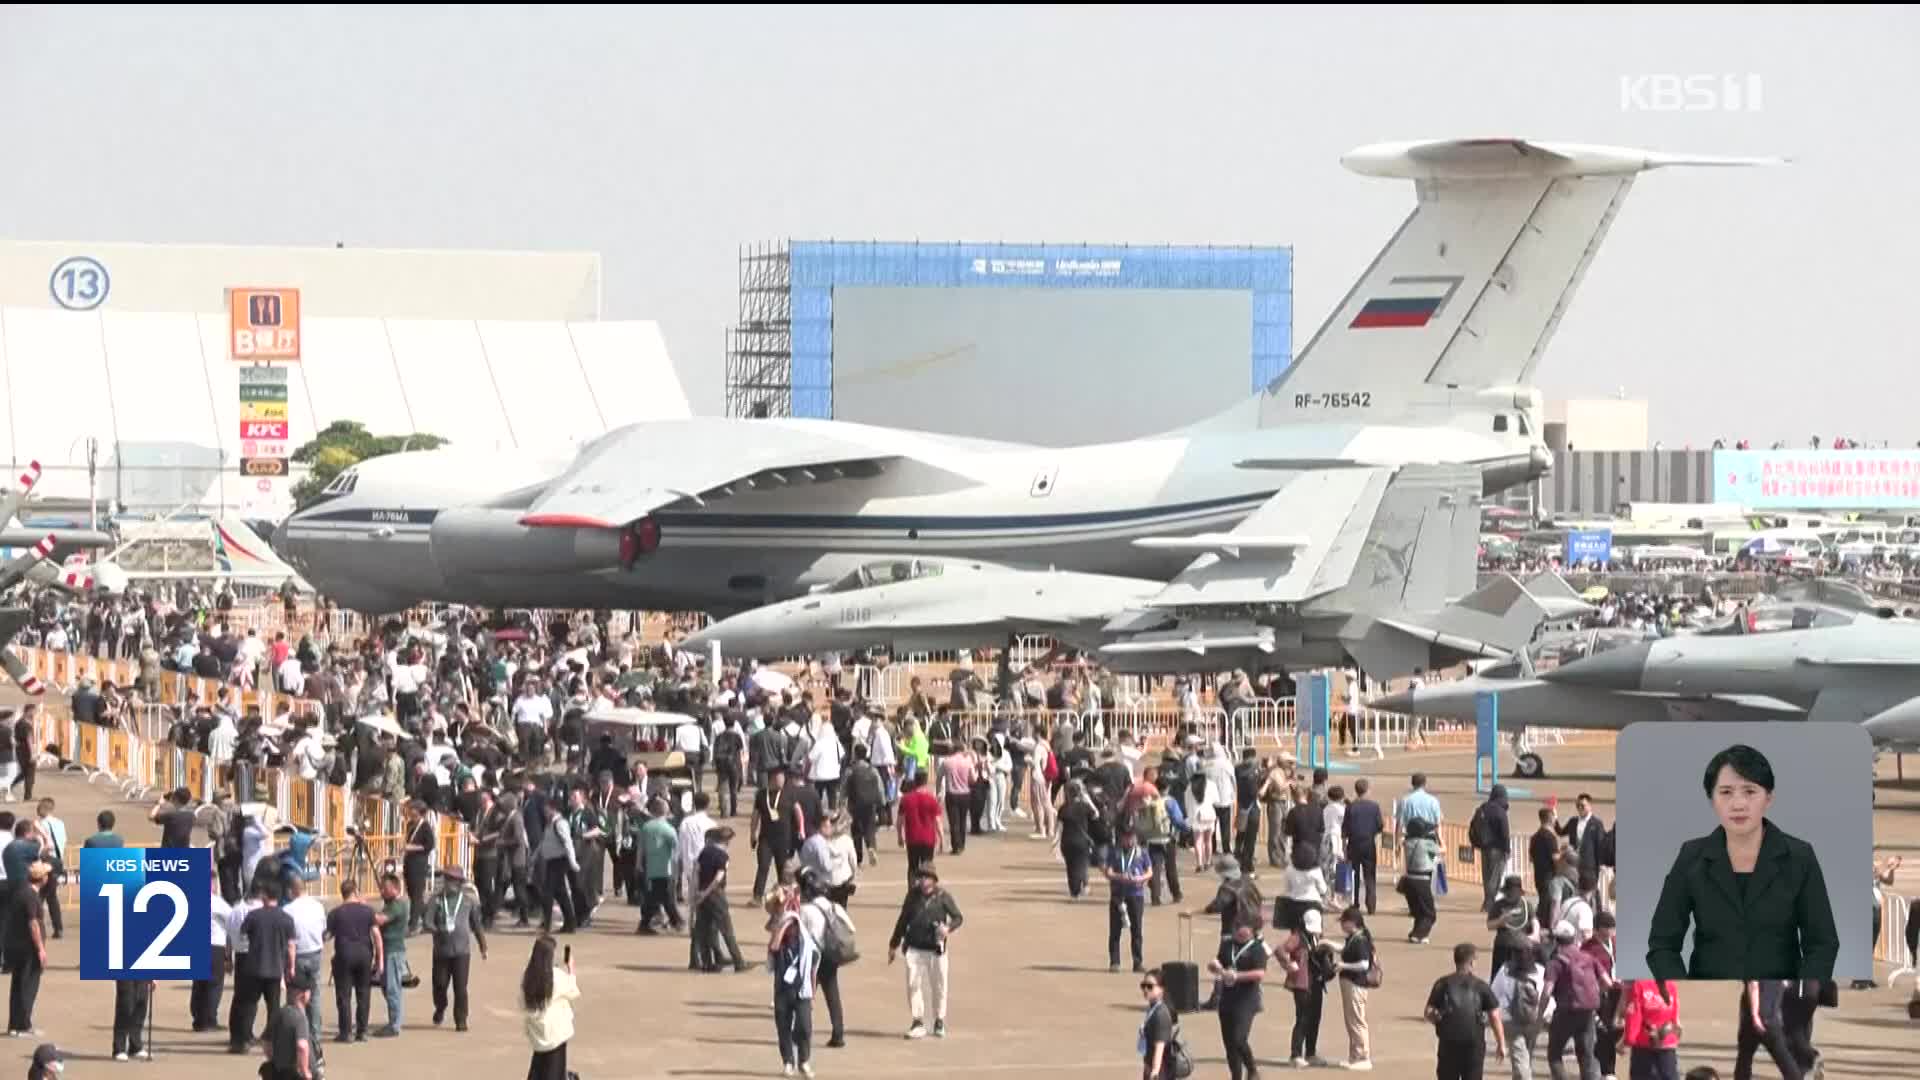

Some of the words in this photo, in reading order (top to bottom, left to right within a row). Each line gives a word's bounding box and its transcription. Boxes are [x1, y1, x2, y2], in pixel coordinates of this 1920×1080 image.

[60, 269, 99, 299] 13
[1295, 392, 1371, 409] RF-76542
[247, 423, 282, 436] KFC
